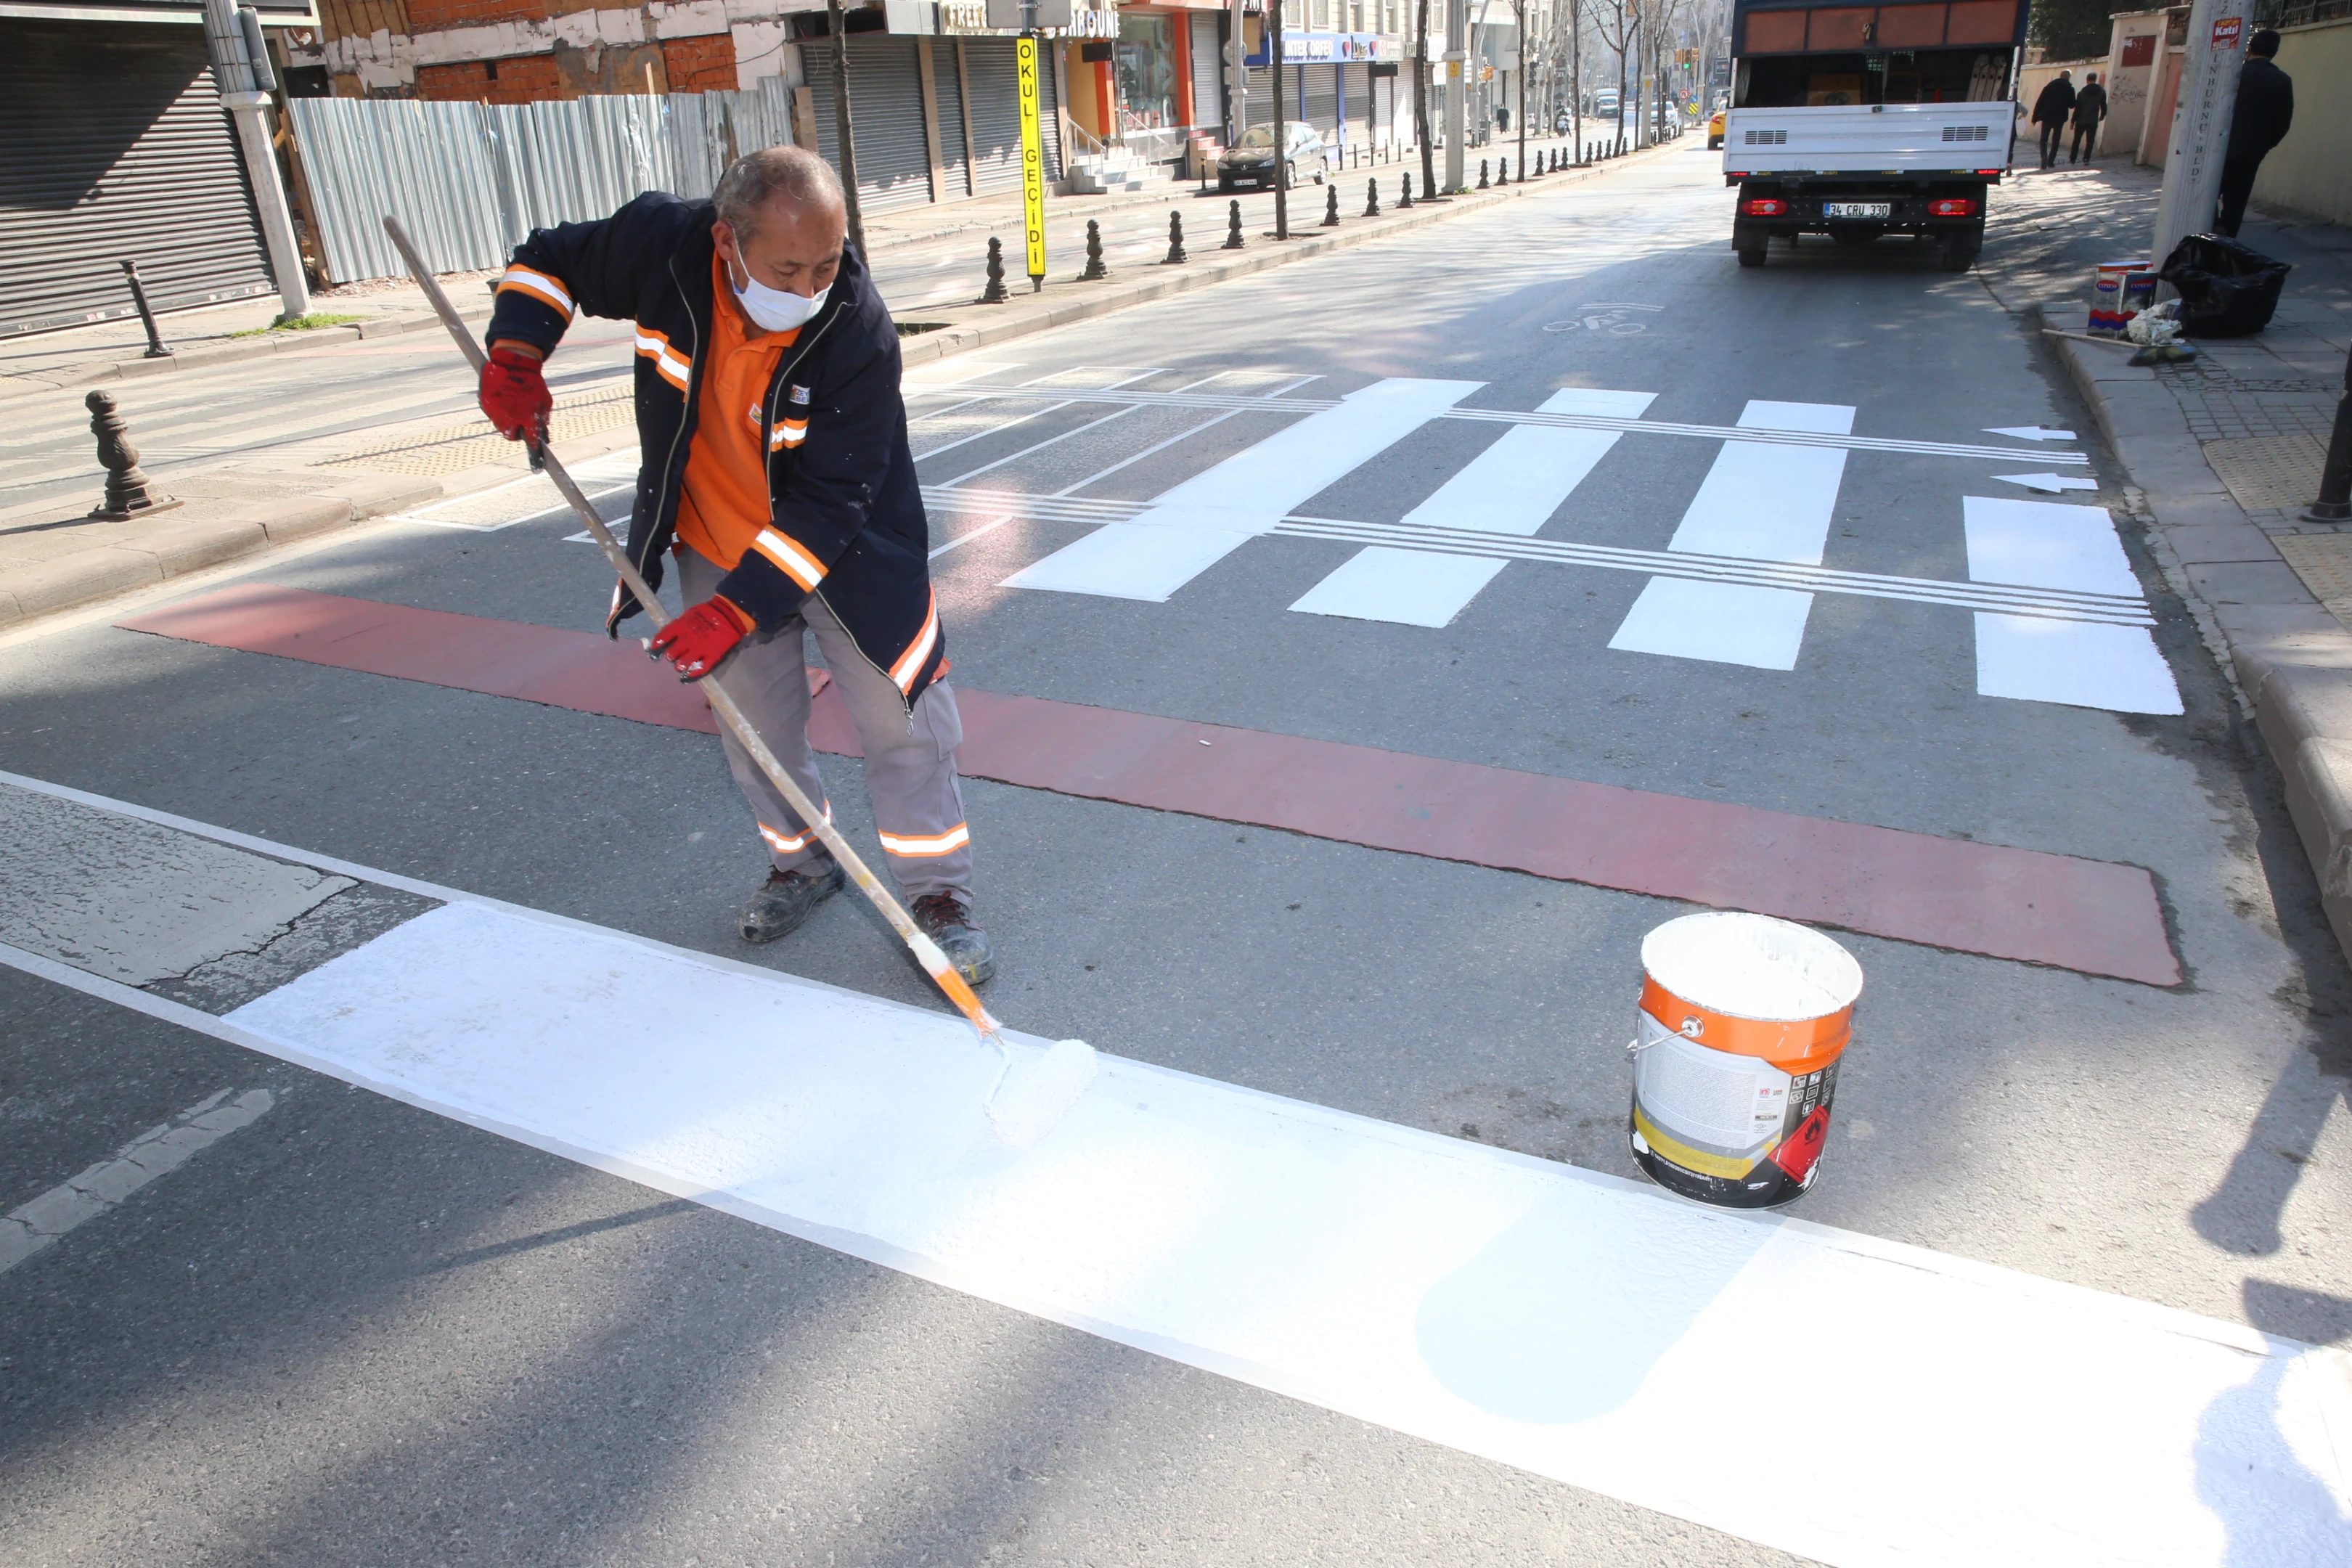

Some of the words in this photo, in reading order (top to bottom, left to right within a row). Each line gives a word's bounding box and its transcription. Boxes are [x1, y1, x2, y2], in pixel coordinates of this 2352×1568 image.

[1019, 45, 1032, 117] OKUL
[1025, 150, 1040, 264] GEÇİDİ
[1830, 205, 1842, 216] 34
[1846, 205, 1865, 216] CRU
[1870, 205, 1887, 216] 330
